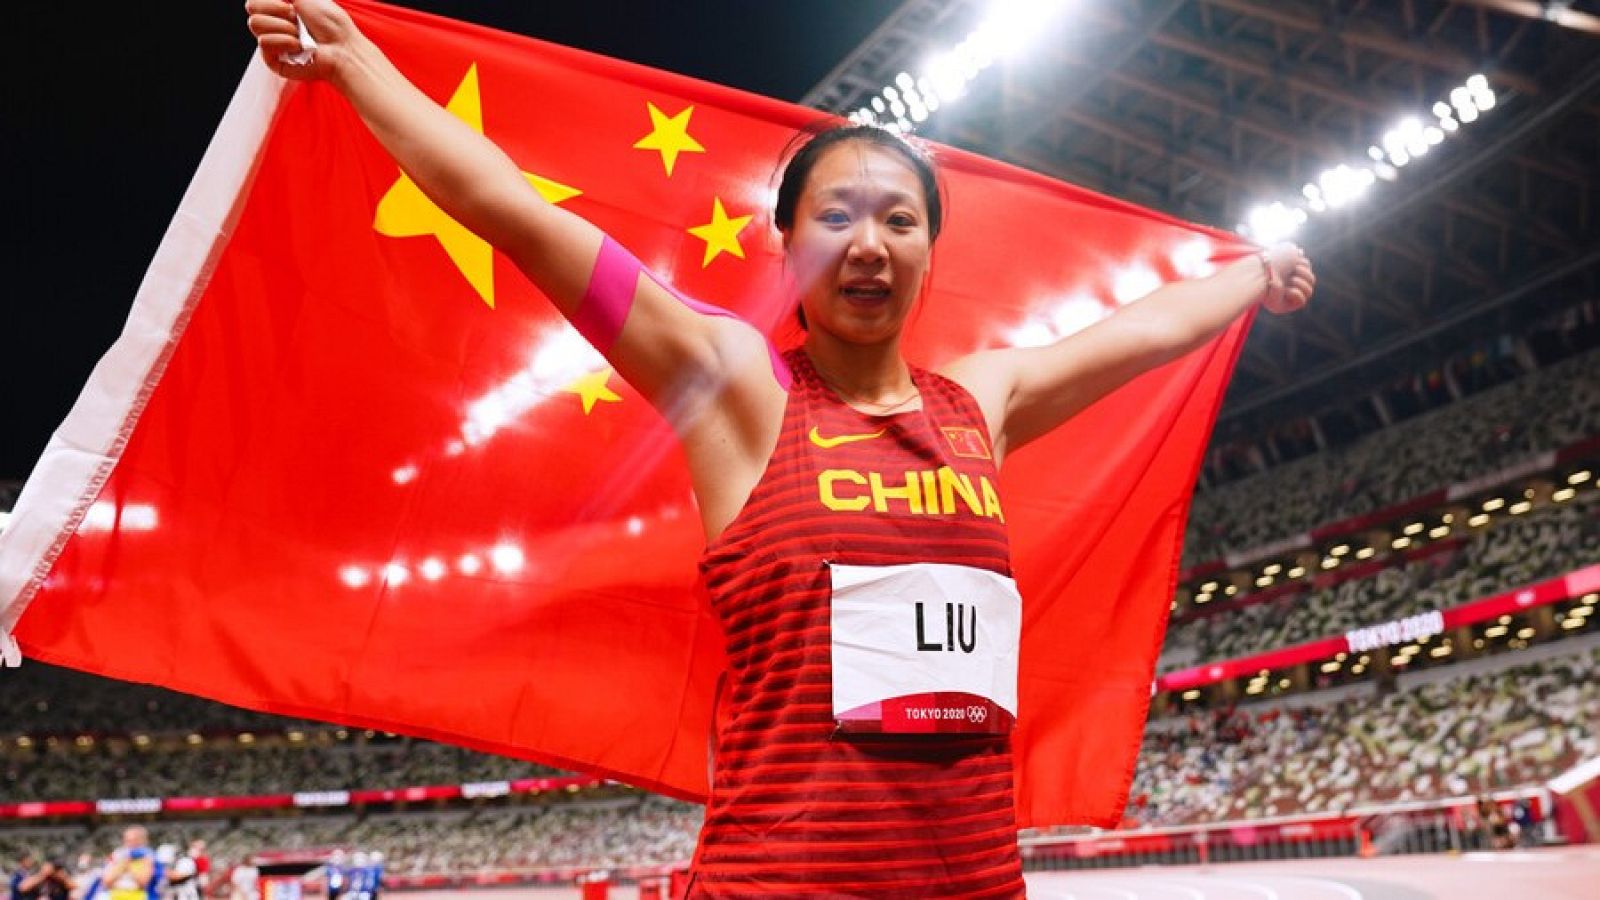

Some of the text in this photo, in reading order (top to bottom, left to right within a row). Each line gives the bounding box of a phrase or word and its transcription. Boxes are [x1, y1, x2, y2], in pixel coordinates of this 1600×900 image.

[818, 466, 1005, 523] CHINA
[915, 602, 977, 653] LIU
[905, 707, 965, 719] TOKYO 2020
